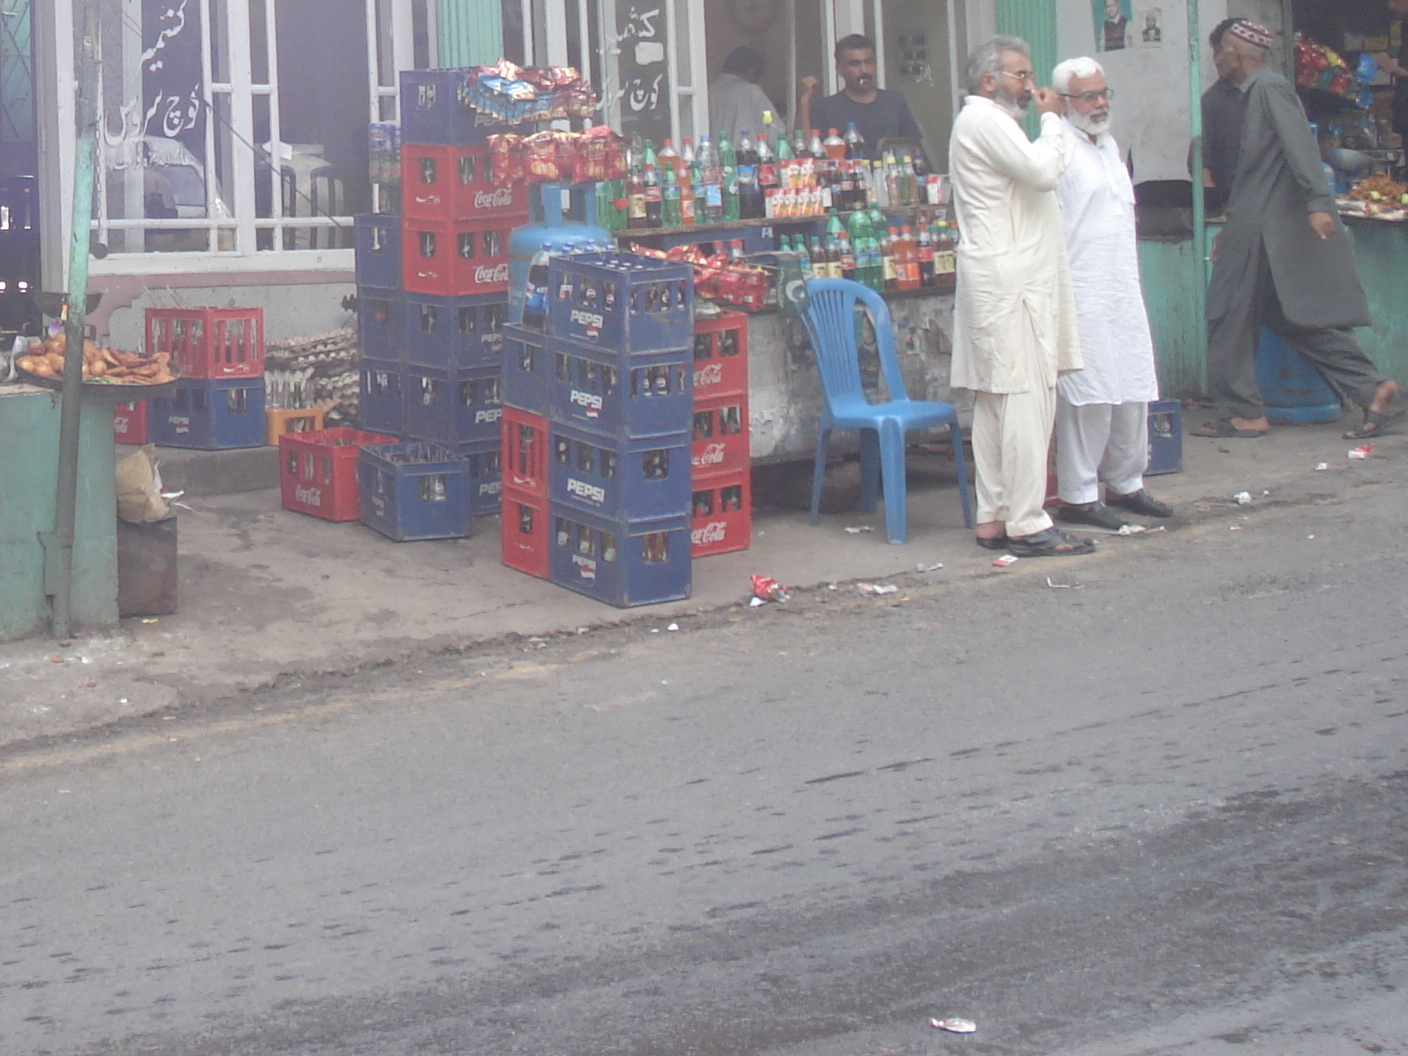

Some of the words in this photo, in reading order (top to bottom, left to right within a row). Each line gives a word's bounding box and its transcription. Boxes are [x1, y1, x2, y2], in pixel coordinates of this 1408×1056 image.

[570, 309, 604, 329] PEPSI
[570, 389, 603, 411] PEPSI
[475, 408, 503, 424] PEP
[479, 481, 503, 496] PEP
[567, 477, 606, 503] PEPSI
